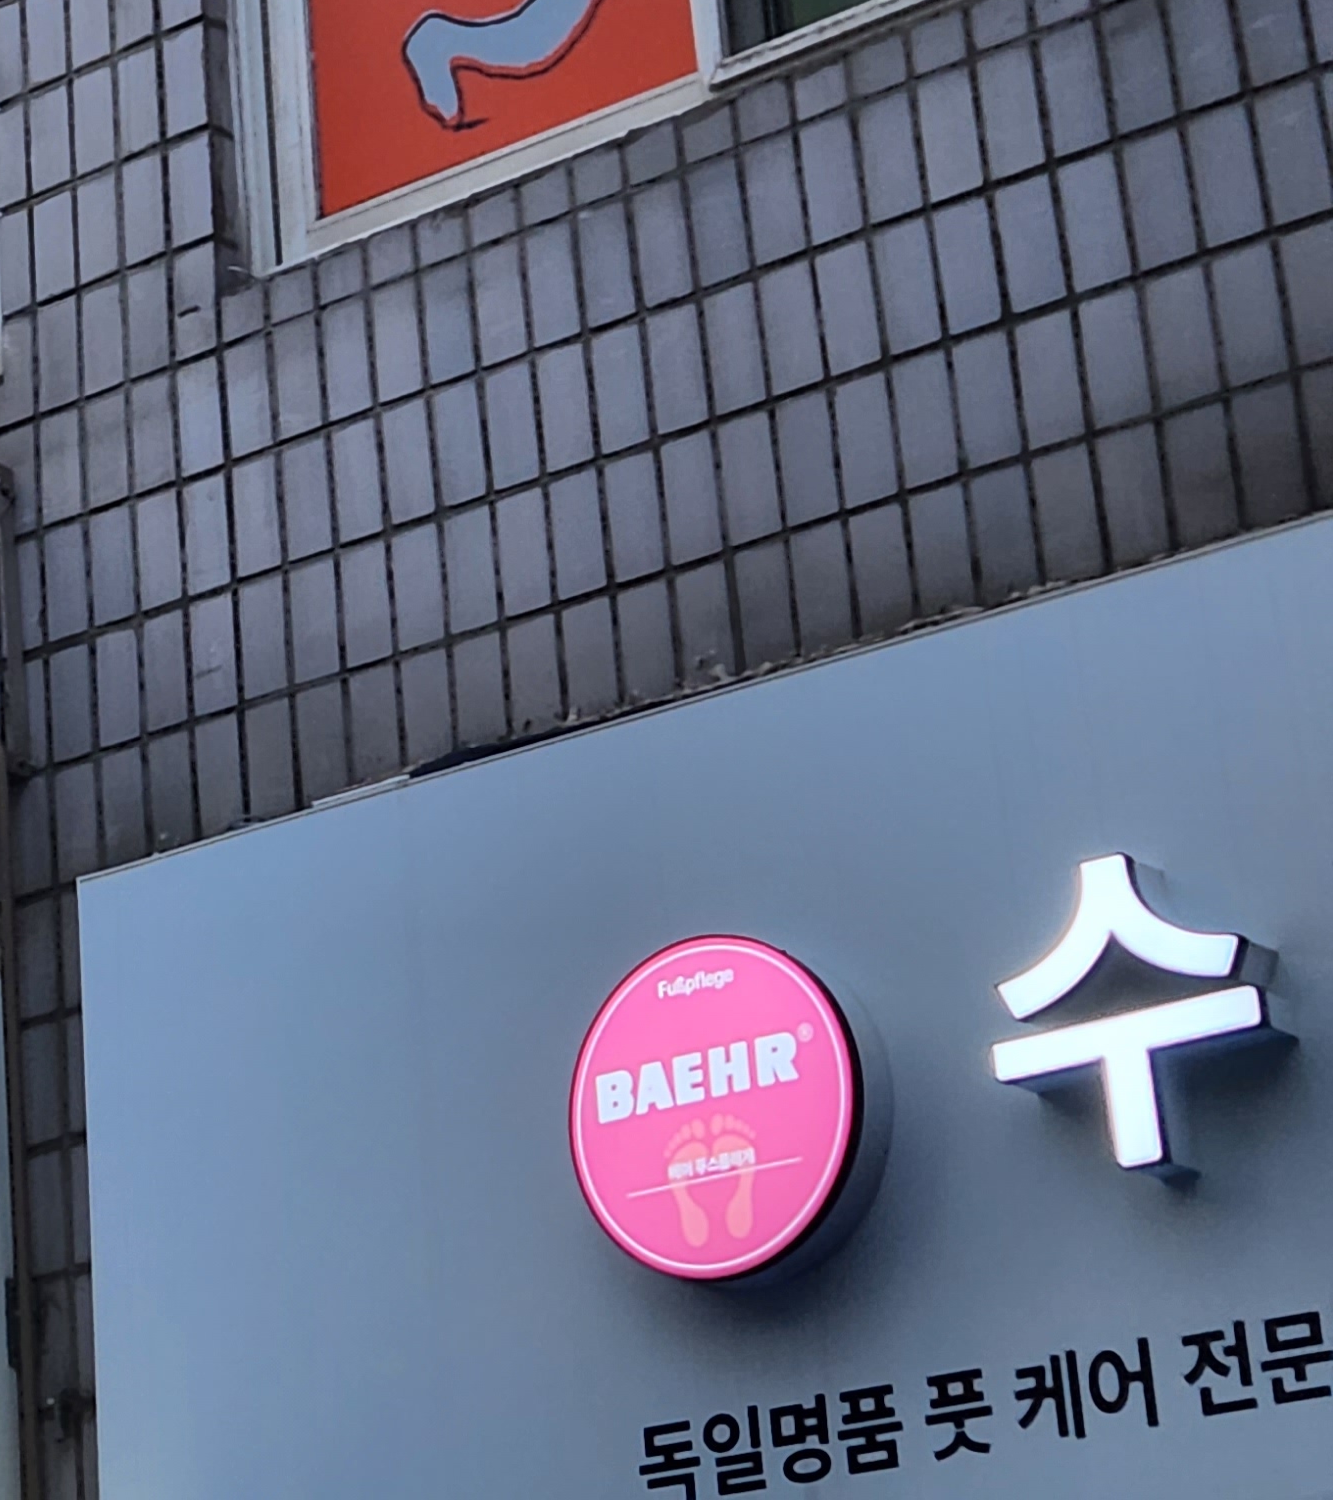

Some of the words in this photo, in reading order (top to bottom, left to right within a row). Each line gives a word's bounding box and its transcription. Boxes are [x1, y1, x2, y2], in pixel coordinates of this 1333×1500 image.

[595, 1030, 798, 1124] BAEHR
[991, 852, 1261, 1168] 수
[638, 1384, 905, 1500] 독일명품
[925, 1368, 993, 1461] 풋
[1014, 1336, 1159, 1440] 케어
[1182, 1310, 1333, 1419] 전문
